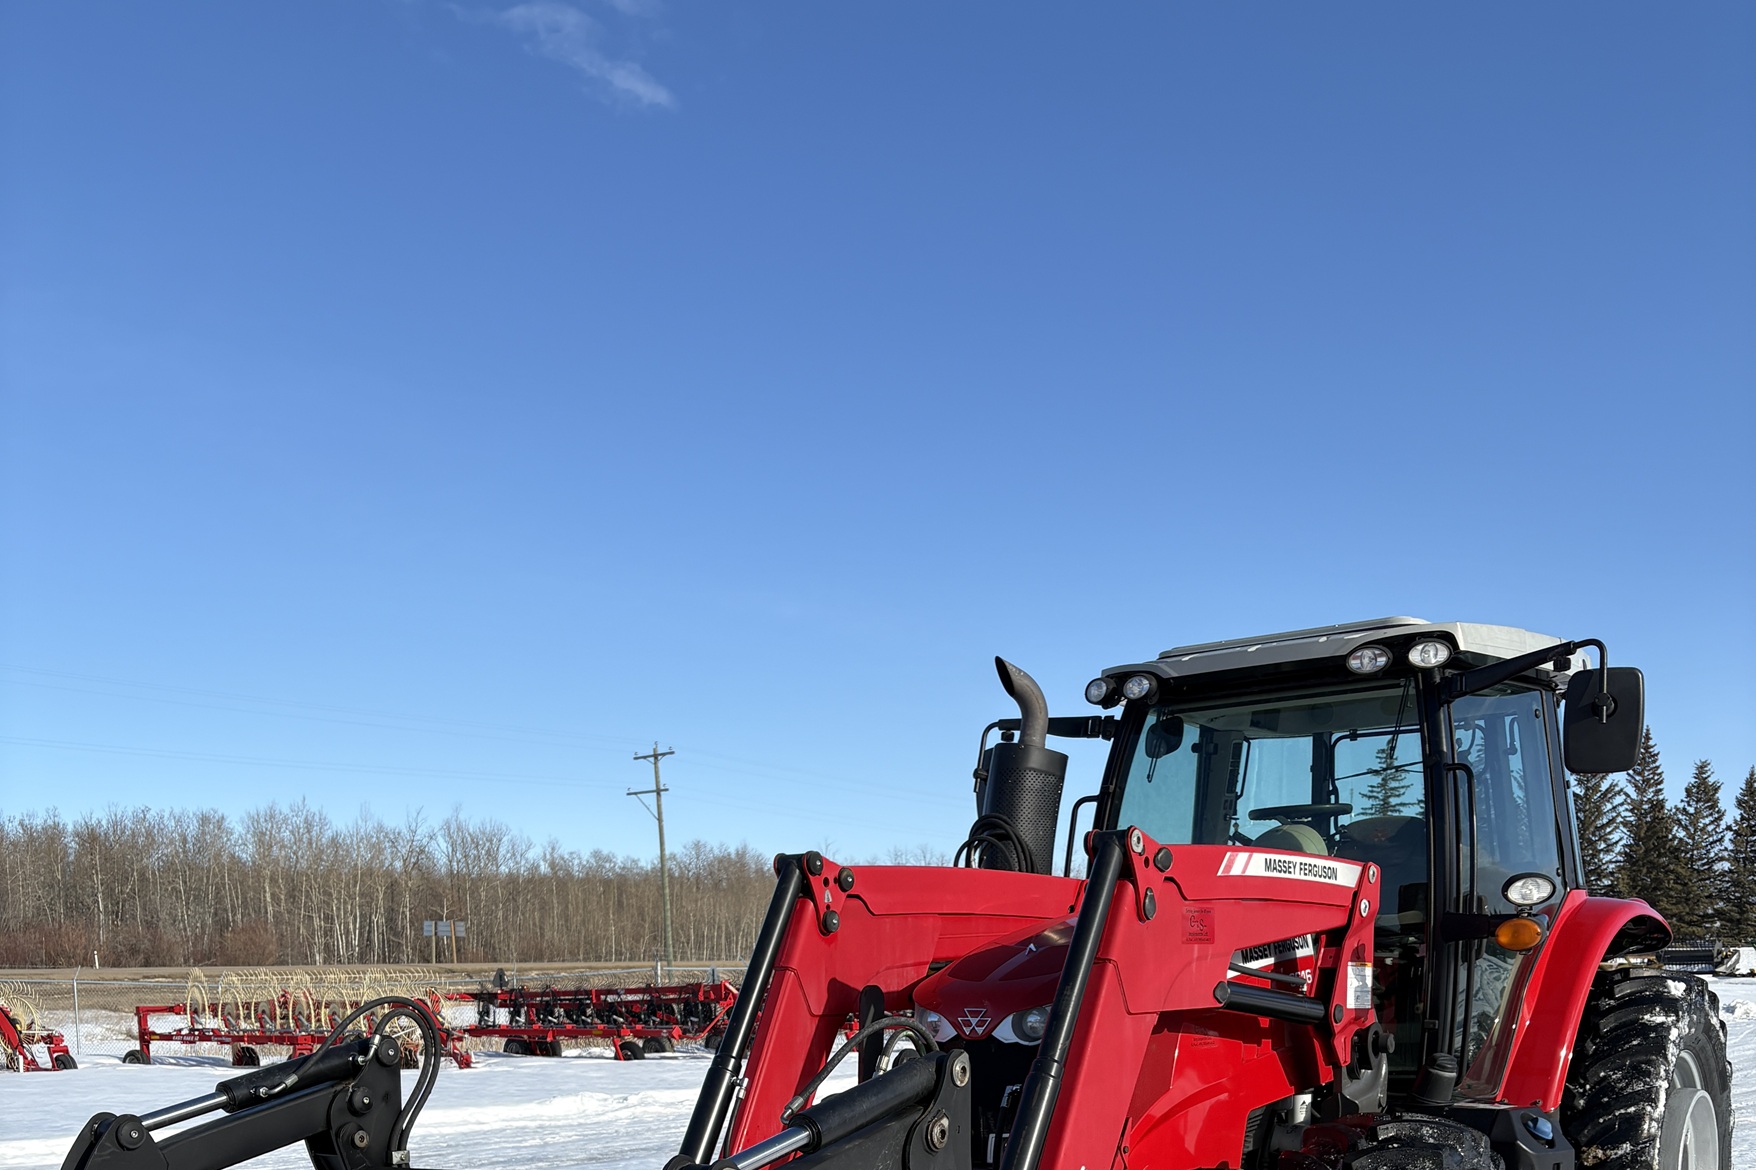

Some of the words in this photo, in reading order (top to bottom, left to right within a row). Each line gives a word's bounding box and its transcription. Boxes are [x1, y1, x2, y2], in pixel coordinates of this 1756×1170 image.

[1264, 857, 1298, 876] MASSEY
[1299, 861, 1338, 881] FERGUSON
[1241, 944, 1272, 965] MASSEY
[1273, 936, 1309, 955] FERGUSON
